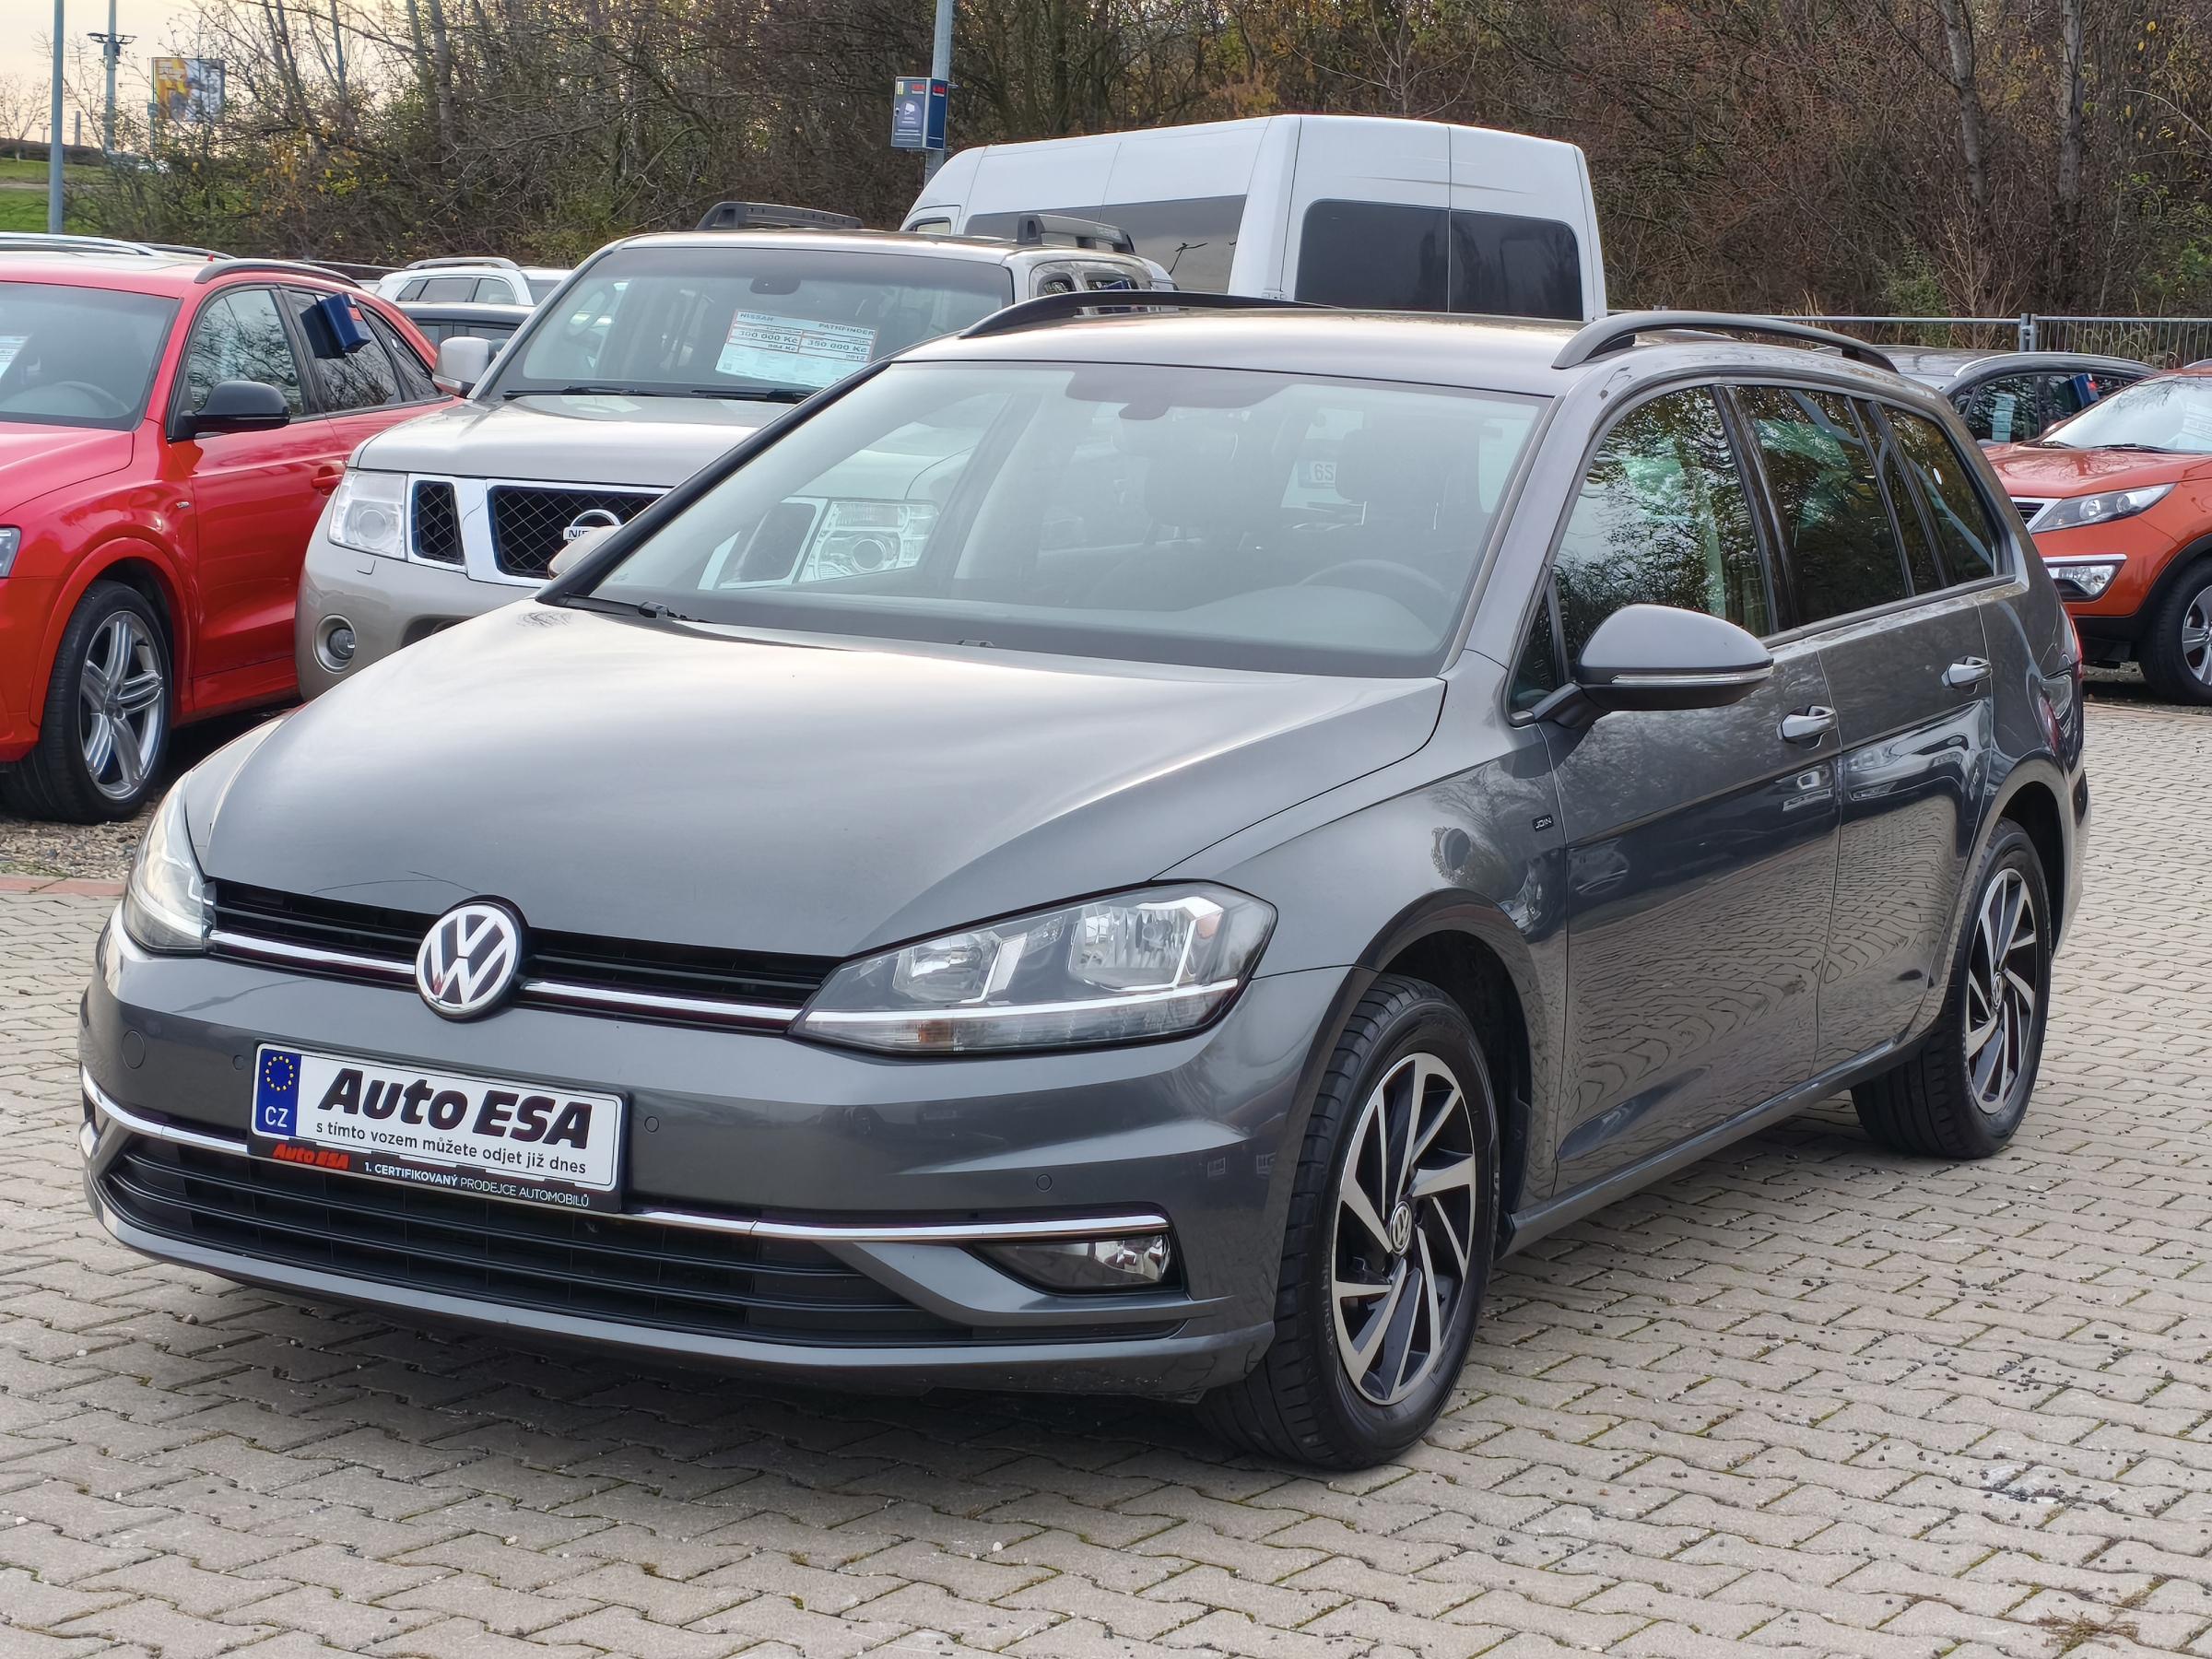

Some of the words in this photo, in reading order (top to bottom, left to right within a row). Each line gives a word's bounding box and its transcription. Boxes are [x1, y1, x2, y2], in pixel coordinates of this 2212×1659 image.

[740, 312, 774, 323] NISSAN
[818, 323, 877, 336] PATHFINDER
[830, 342, 850, 352] 000
[265, 1105, 289, 1128] CZ
[317, 1067, 468, 1131] Auto
[472, 1089, 593, 1150] ESA
[272, 1142, 315, 1164] Auto
[316, 1122, 324, 1134] s
[327, 1121, 366, 1140] tímto
[371, 1131, 418, 1148] vozem
[422, 1136, 478, 1158] můžete
[482, 1147, 523, 1165] odjet
[525, 1152, 545, 1169] již
[549, 1156, 586, 1174] dnes
[364, 1161, 372, 1172] 1.
[374, 1163, 458, 1187] CERTIFIKOVANÝ
[460, 1177, 517, 1196] PRODEJCE
[519, 1186, 590, 1208] AUTOMOBILŮ
